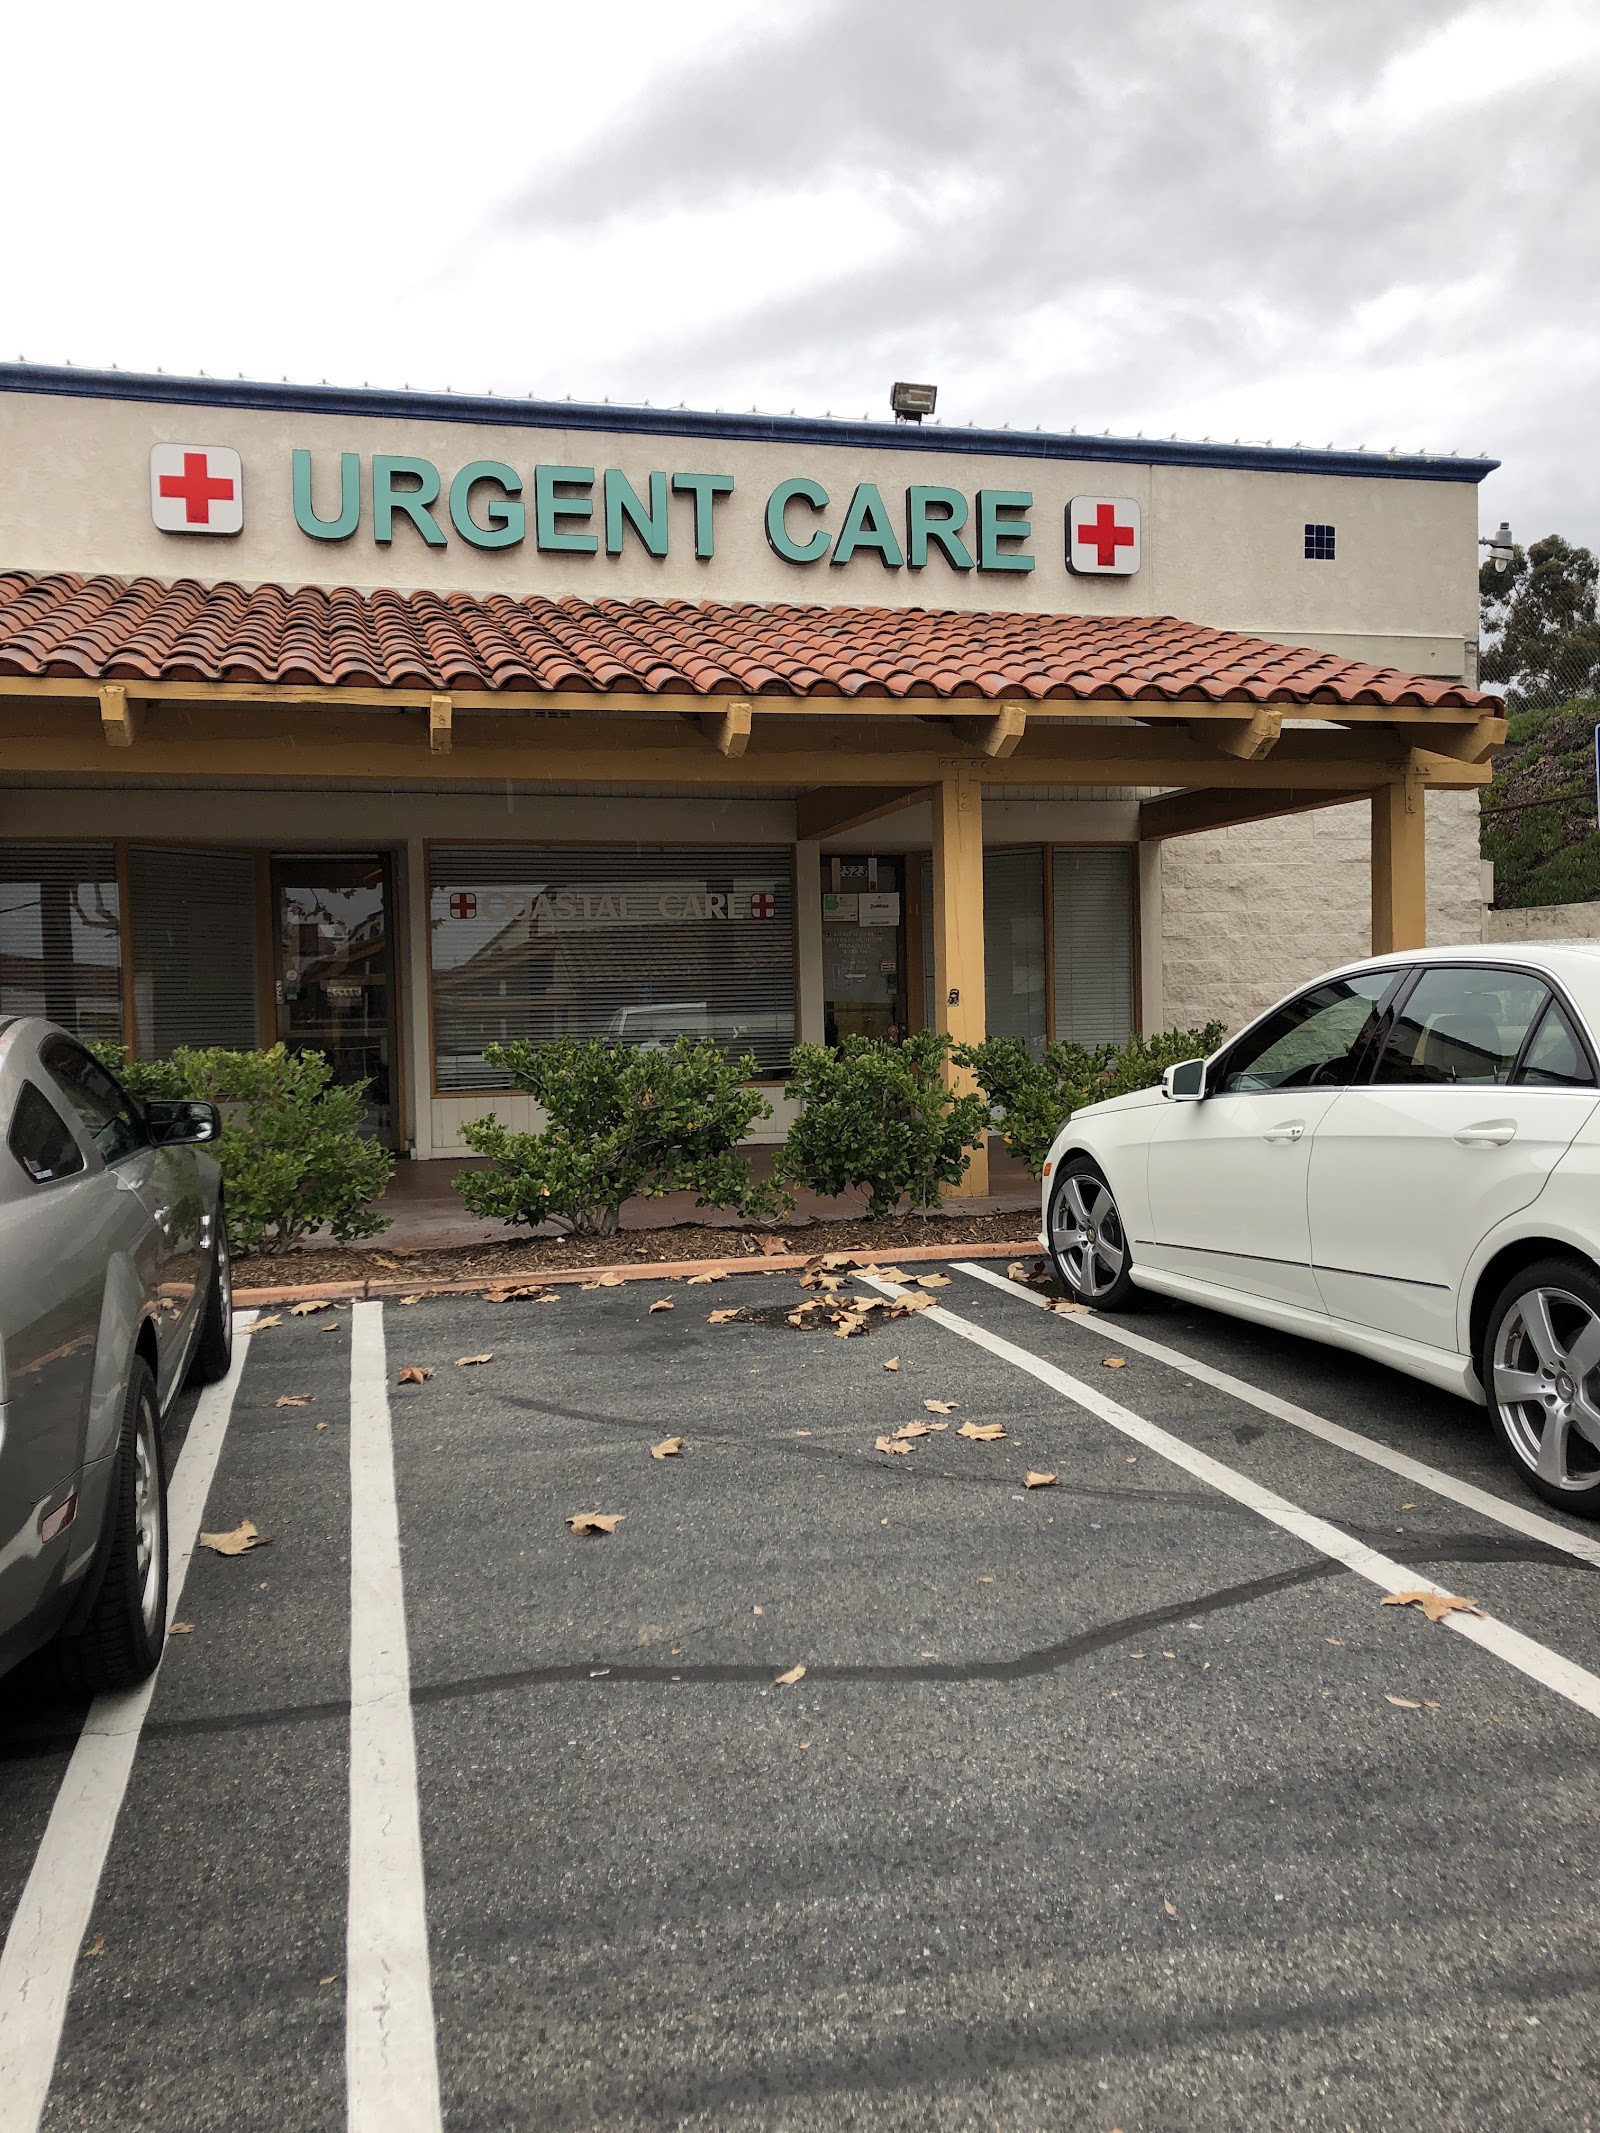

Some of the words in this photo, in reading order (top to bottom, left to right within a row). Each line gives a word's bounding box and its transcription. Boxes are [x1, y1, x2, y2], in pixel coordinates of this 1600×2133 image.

[291, 448, 734, 560] URGENT
[764, 477, 1036, 574] CARE
[482, 891, 640, 921] COASTAL
[658, 891, 745, 920] CARE
